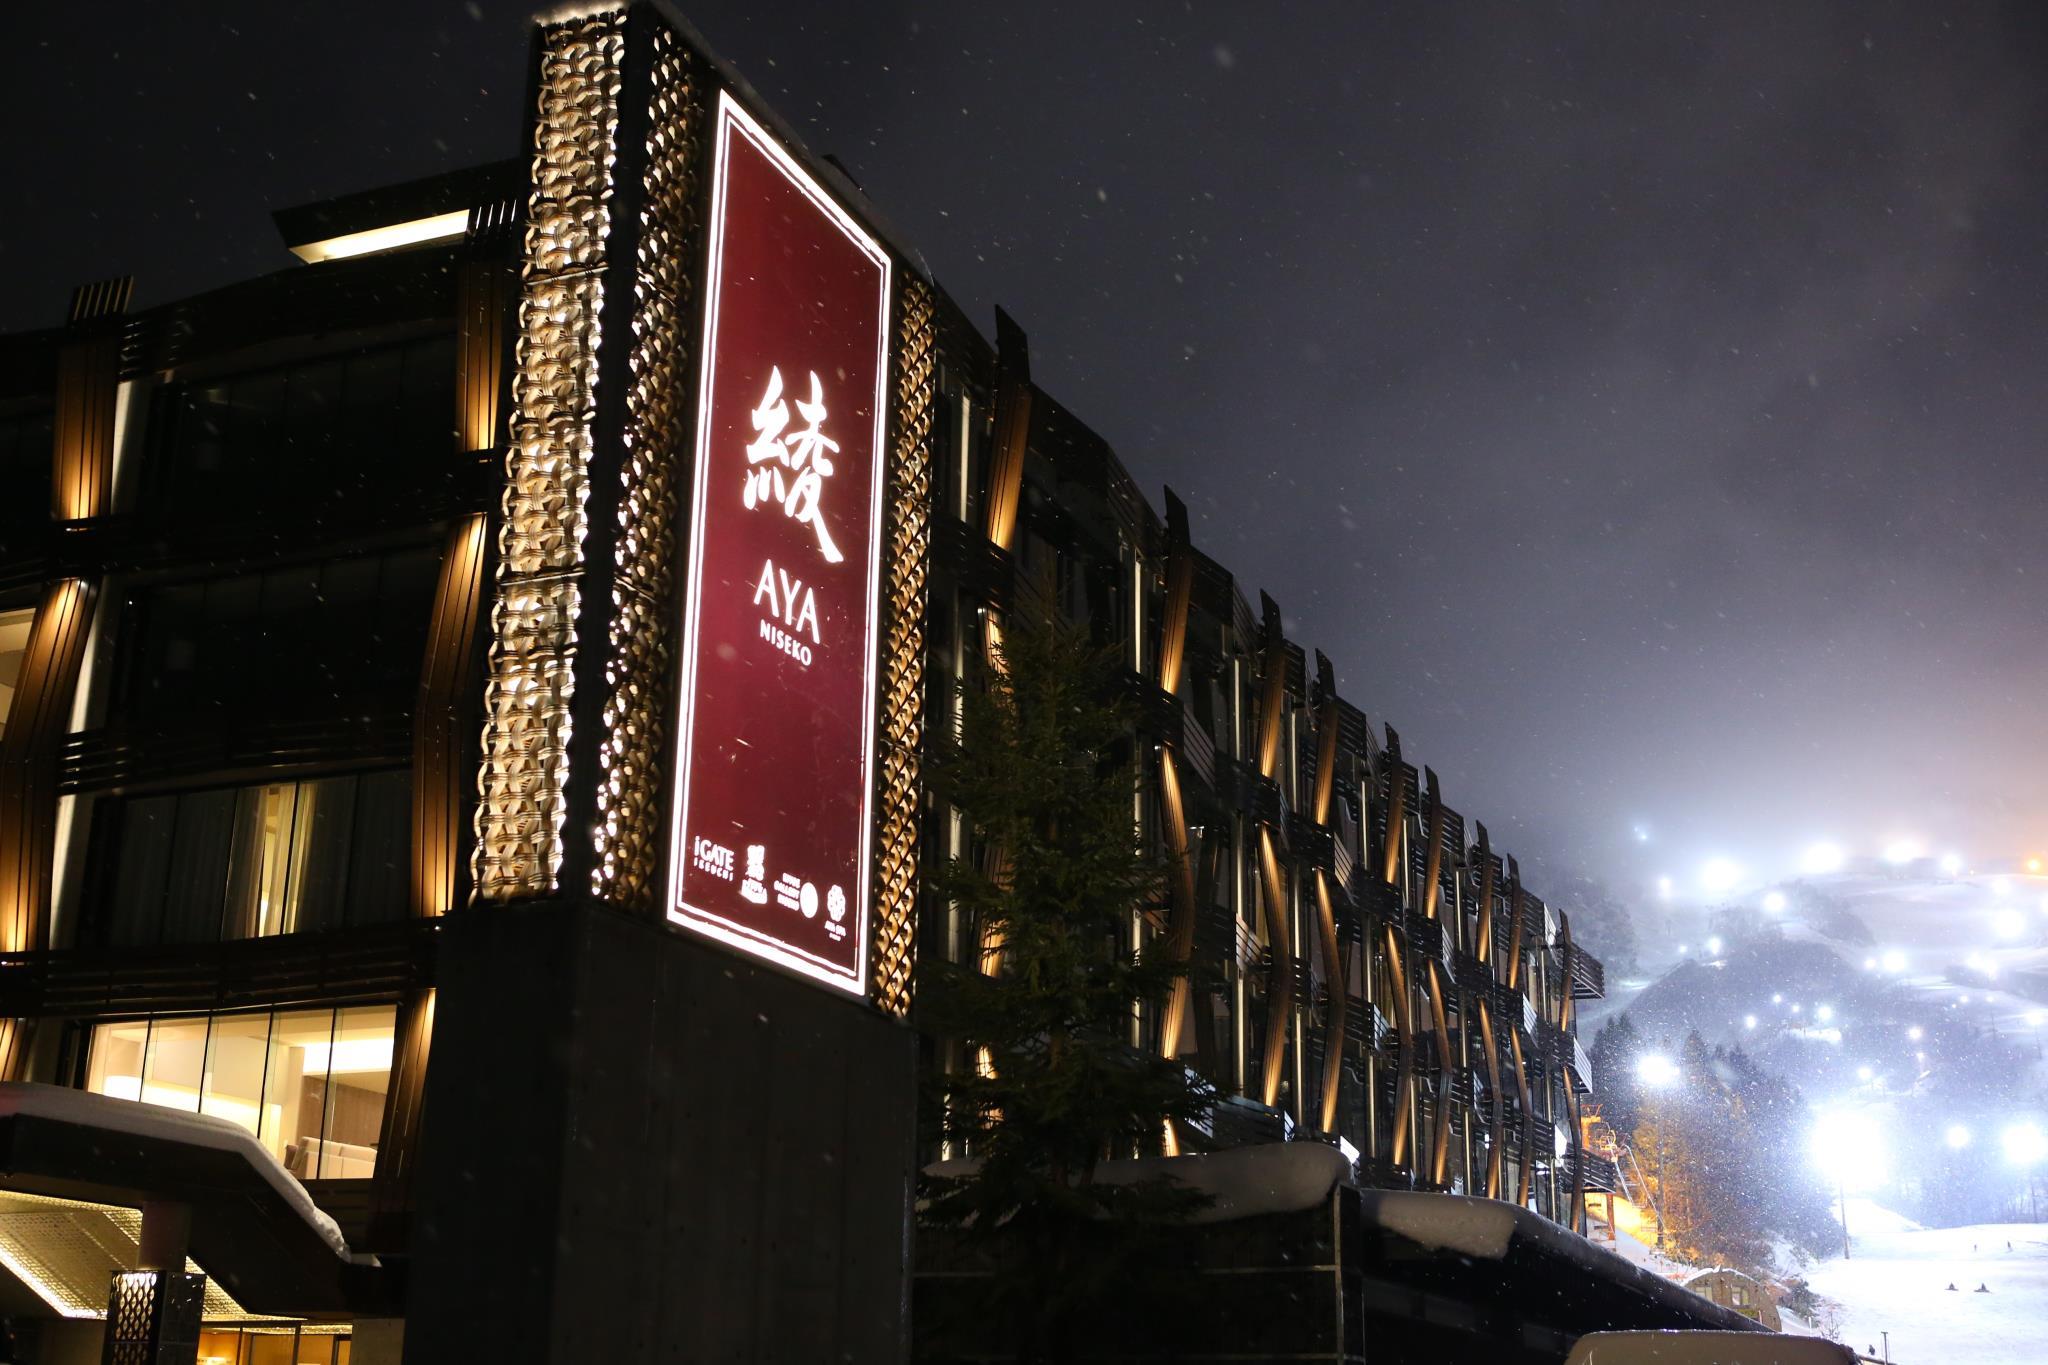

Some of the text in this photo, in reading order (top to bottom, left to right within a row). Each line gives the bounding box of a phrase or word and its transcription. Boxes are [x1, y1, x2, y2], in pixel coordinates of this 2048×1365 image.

[742, 365, 844, 563] 綾
[754, 559, 820, 644] AYA
[760, 619, 812, 666] NISEKO
